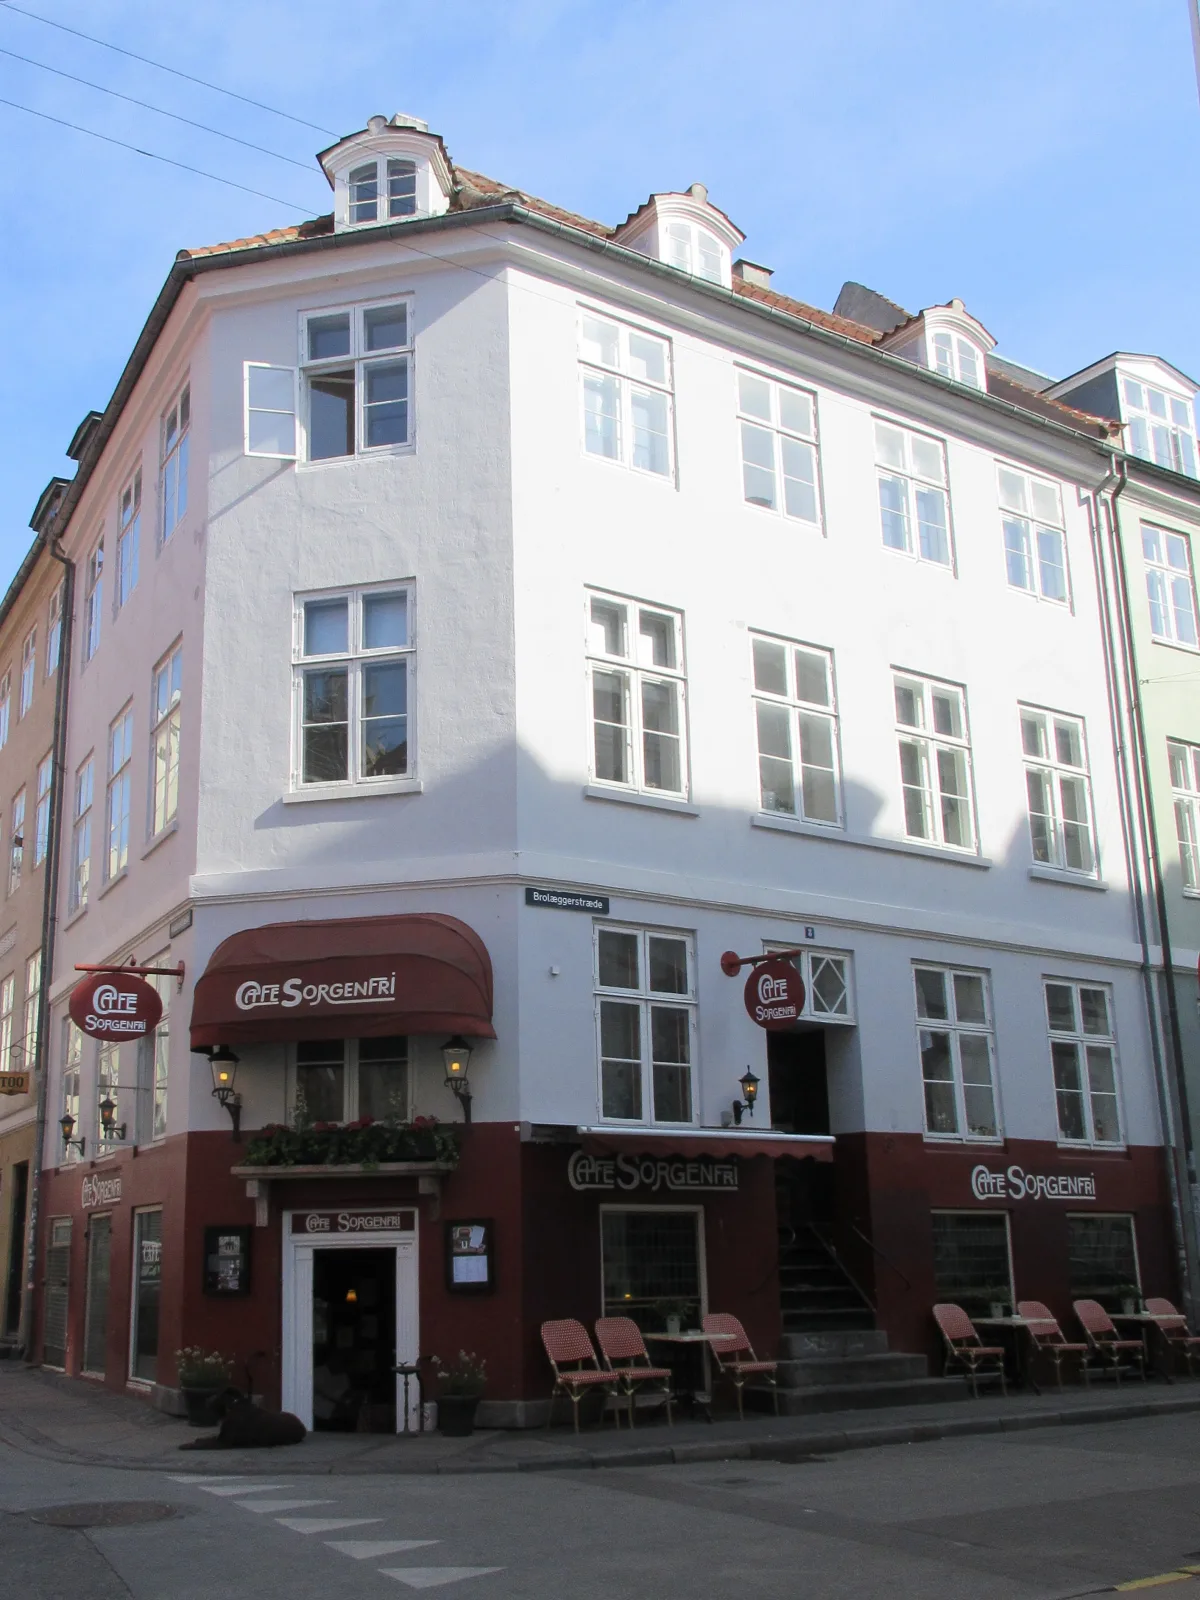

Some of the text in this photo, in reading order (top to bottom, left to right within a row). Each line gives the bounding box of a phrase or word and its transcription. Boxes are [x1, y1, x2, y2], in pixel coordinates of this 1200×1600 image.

[533, 891, 603, 909] Brolæggerstræde
[92, 984, 138, 1015] CAFE
[235, 971, 396, 1011] CAFE SORGENFRI
[758, 974, 788, 1004] CAFE
[85, 1014, 147, 1032] SORGENFRI
[755, 1004, 796, 1021] SORGENFRI
[567, 1150, 615, 1191] CAFE
[971, 1165, 1096, 1200] CAFE SORGENFRI
[305, 1212, 401, 1233] CAFE SORGENFRI
